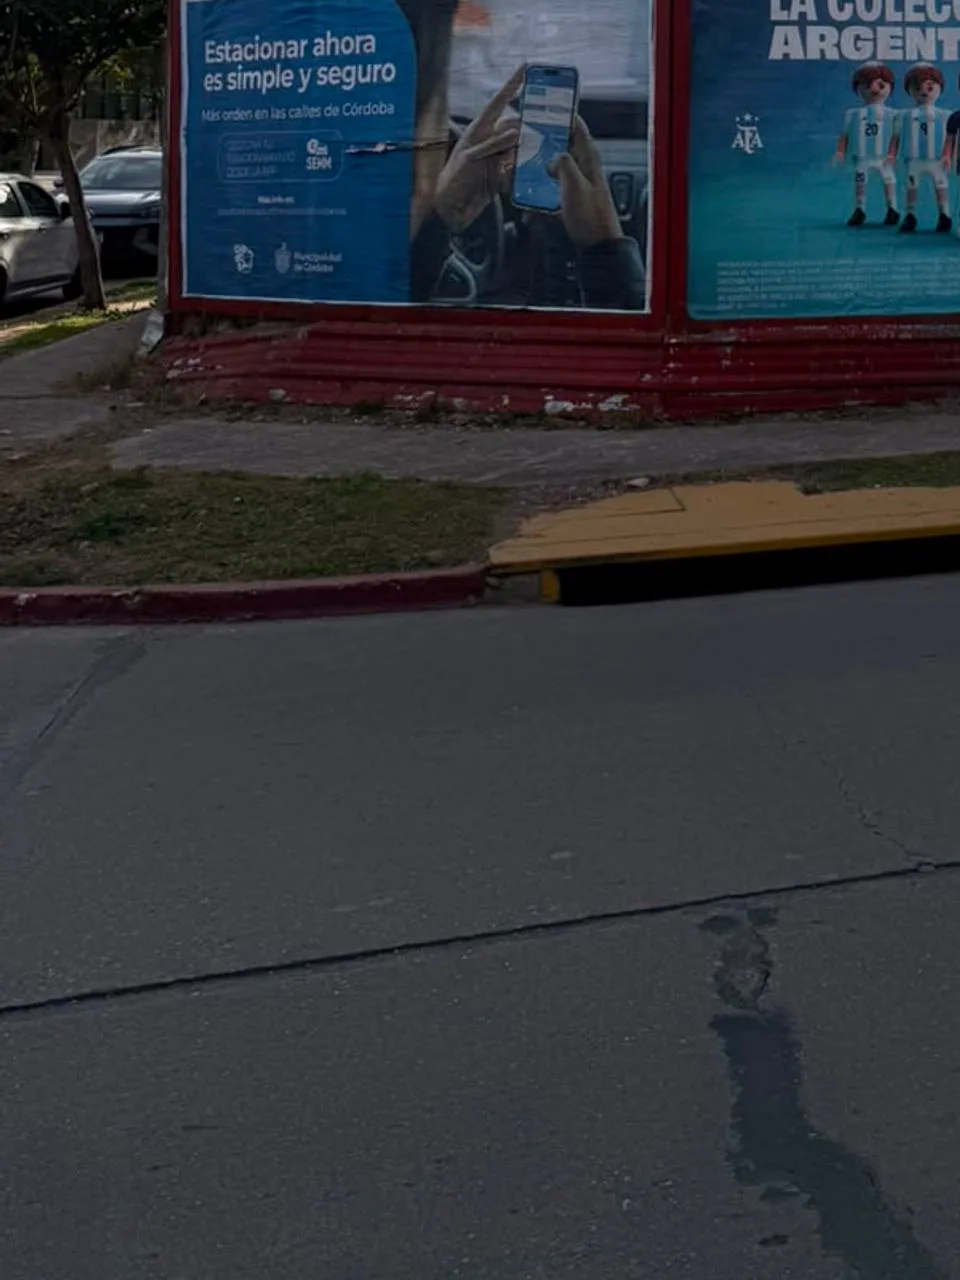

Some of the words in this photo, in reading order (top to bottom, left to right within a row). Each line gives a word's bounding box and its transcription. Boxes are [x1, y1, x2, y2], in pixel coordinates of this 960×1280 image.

[204, 36, 309, 64] Estacionar
[313, 31, 377, 57] ahora
[203, 72, 224, 93] es
[227, 64, 295, 95] simple
[297, 66, 312, 94] y
[316, 61, 397, 91] seguro
[222, 107, 253, 121] orden
[254, 109, 269, 120] en
[270, 106, 287, 120] las
[288, 104, 321, 119] calles
[323, 103, 339, 117] de
[341, 101, 396, 116] Córdoba
[864, 122, 878, 136] 20
[920, 122, 929, 136] 9
